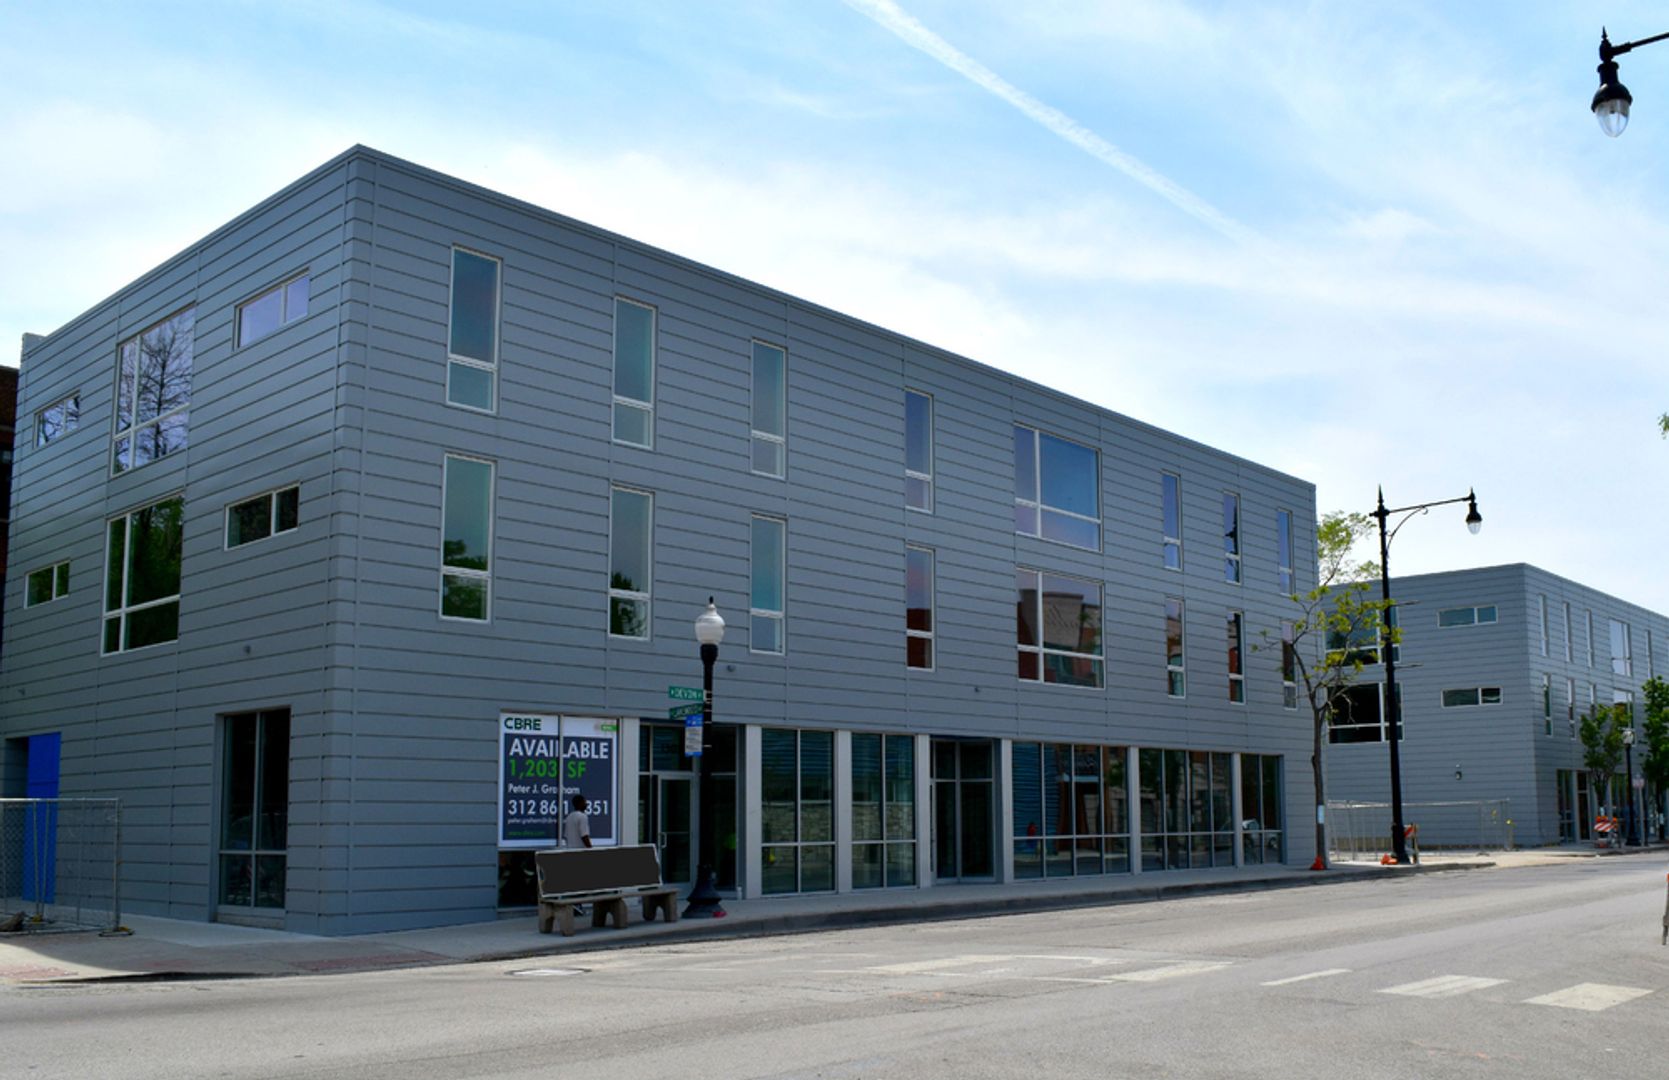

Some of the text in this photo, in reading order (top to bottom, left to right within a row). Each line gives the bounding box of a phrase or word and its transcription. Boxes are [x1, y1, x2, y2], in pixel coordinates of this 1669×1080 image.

[504, 717, 542, 731] CBRE
[509, 759, 587, 780] 1,203 SF
[507, 783, 530, 794] Peter
[508, 800, 536, 815] 312
